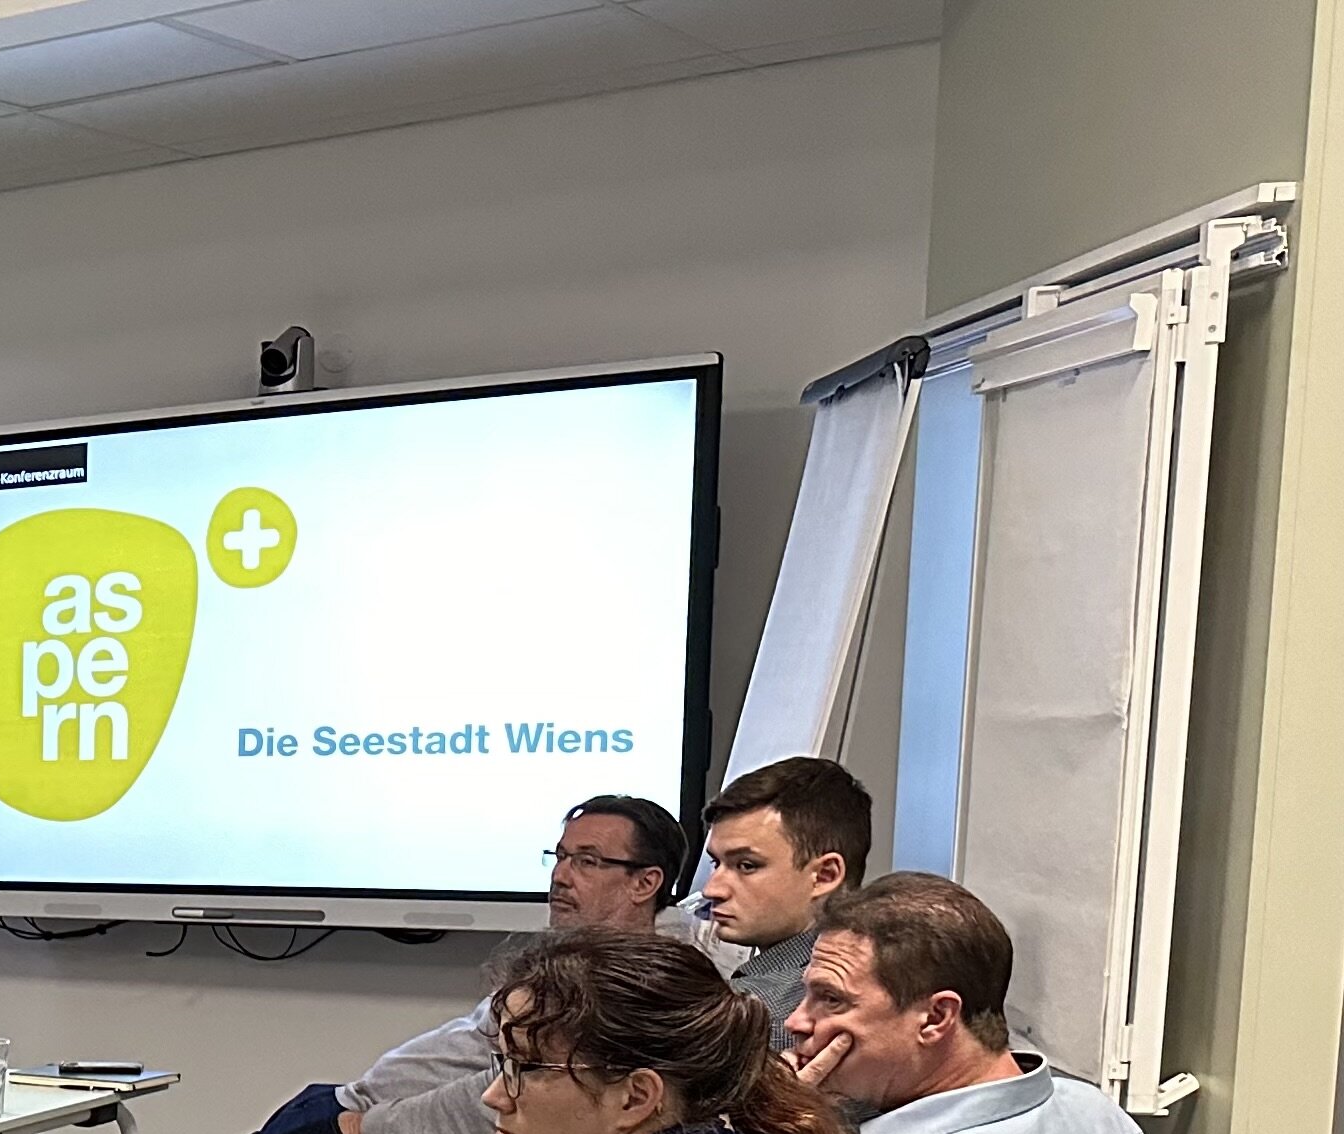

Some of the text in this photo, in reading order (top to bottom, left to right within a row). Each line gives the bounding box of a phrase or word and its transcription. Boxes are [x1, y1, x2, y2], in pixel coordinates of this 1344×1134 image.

[42, 571, 143, 635] as
[22, 636, 129, 717] pe
[42, 701, 129, 761] rn
[238, 722, 634, 757] Die Seestadt Wiens
